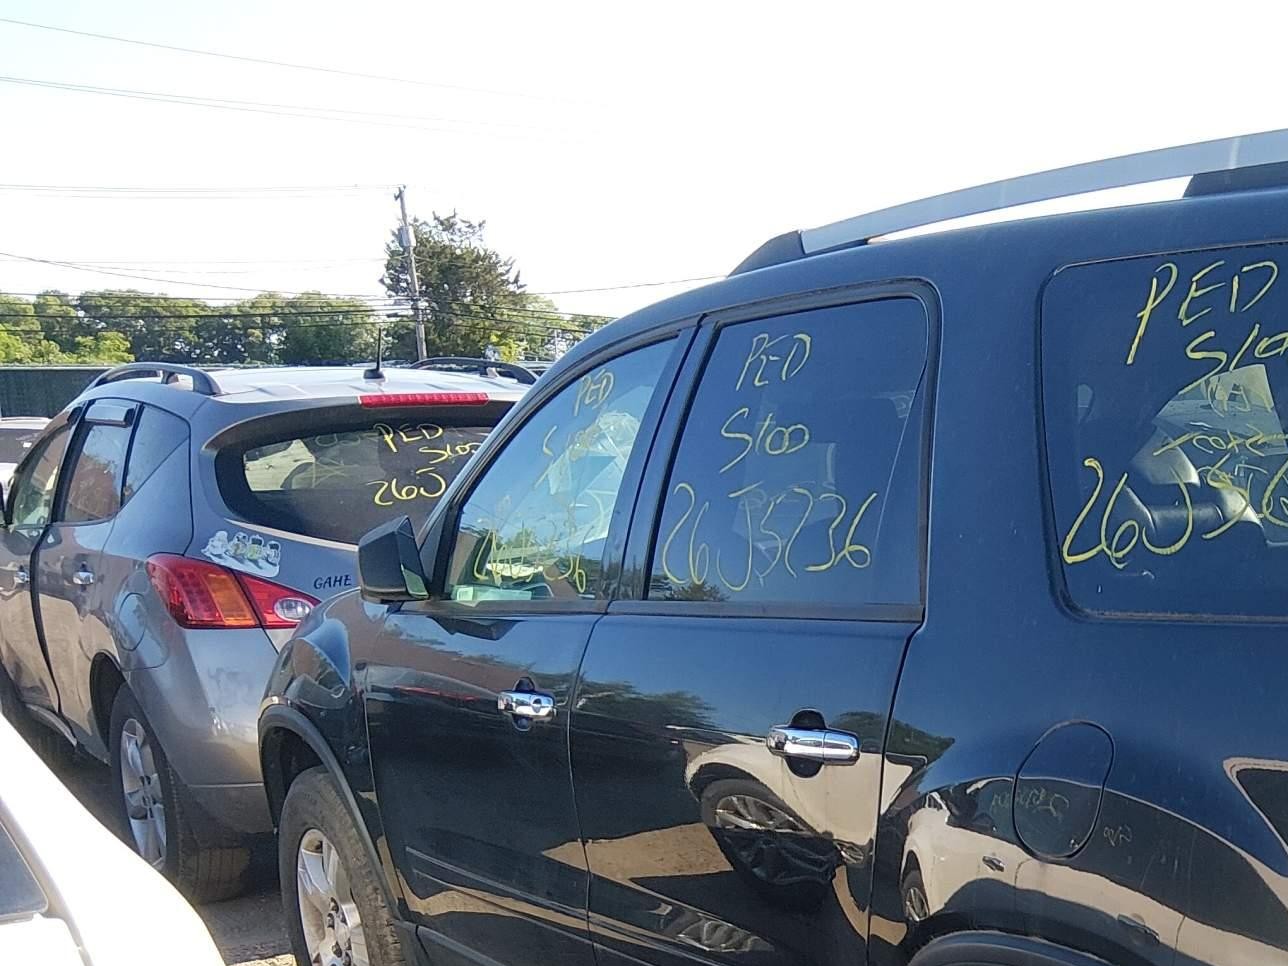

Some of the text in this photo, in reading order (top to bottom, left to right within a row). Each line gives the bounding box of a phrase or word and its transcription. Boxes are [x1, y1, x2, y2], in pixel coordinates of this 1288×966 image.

[1126, 261, 1278, 364] PED
[736, 333, 812, 391] PED
[373, 424, 443, 452] PED
